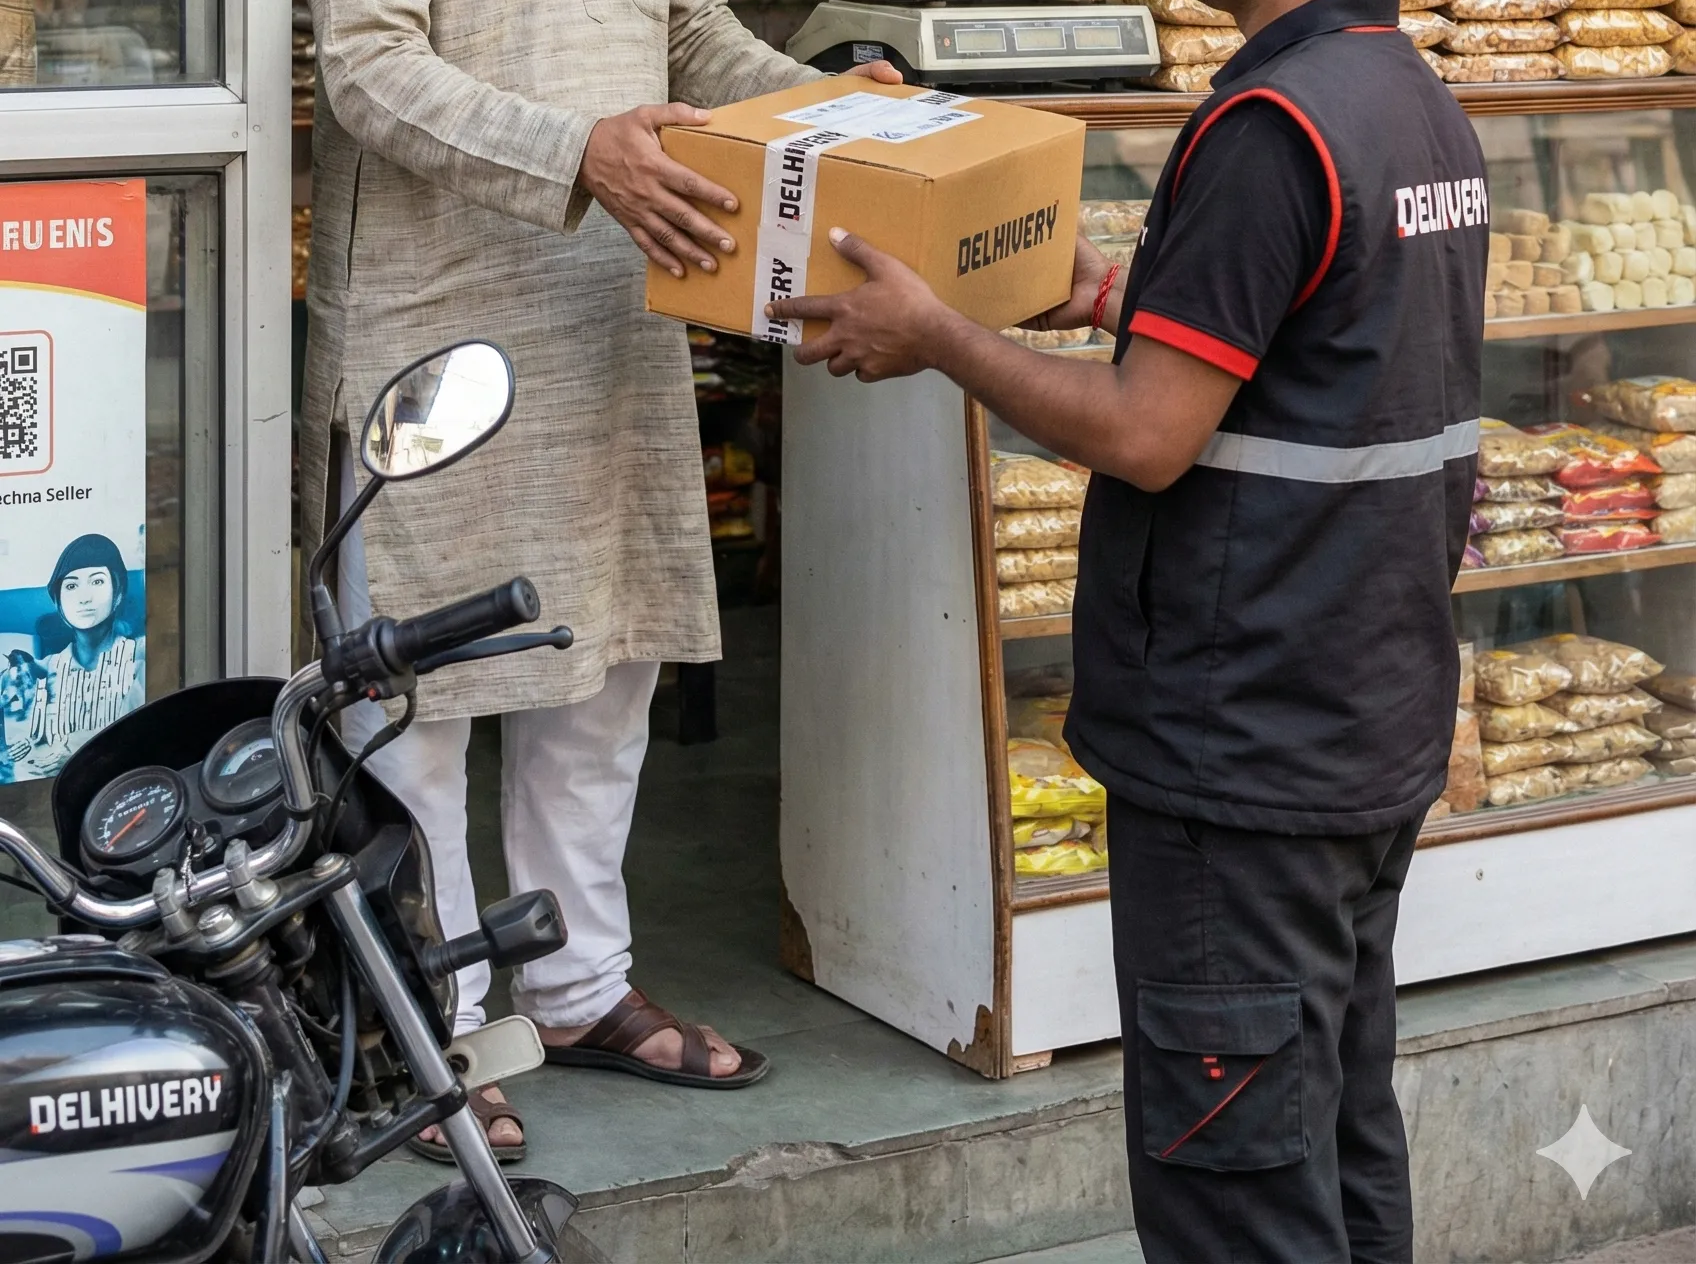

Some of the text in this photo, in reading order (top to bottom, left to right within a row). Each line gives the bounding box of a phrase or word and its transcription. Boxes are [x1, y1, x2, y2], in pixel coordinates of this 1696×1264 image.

[957, 200, 1059, 277] DELHIVERY
[0, 485, 93, 505] chna Seller
[29, 1074, 222, 1134] DELHIVERY
